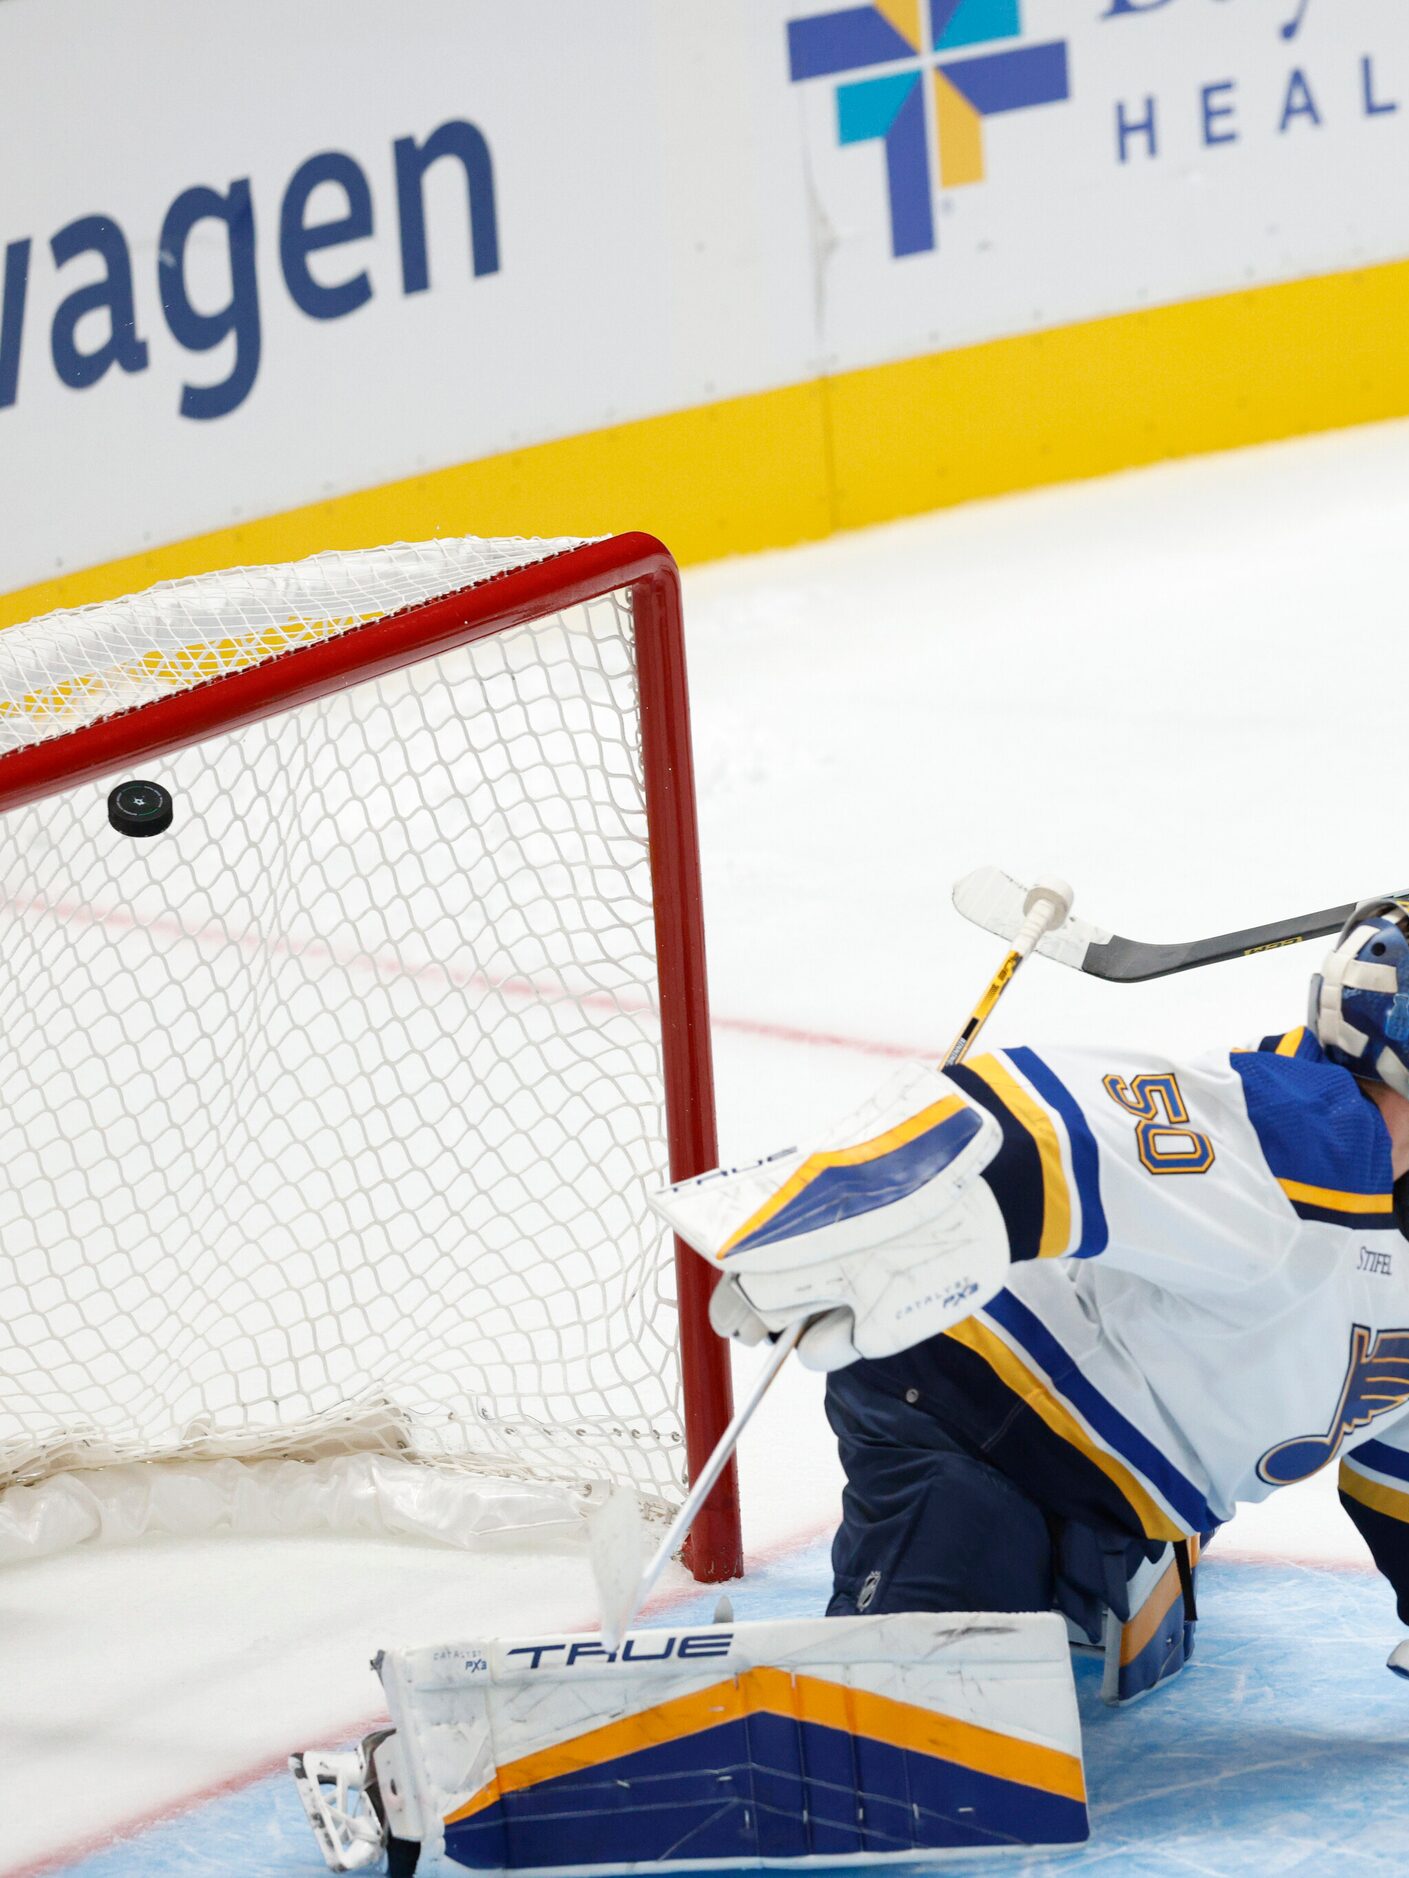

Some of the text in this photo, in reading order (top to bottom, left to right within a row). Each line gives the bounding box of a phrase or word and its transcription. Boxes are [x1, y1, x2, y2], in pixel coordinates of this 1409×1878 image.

[1102, 1073, 1216, 1176] 50
[465, 1658, 487, 1673] PX3
[507, 1633, 735, 1670] TRUE
